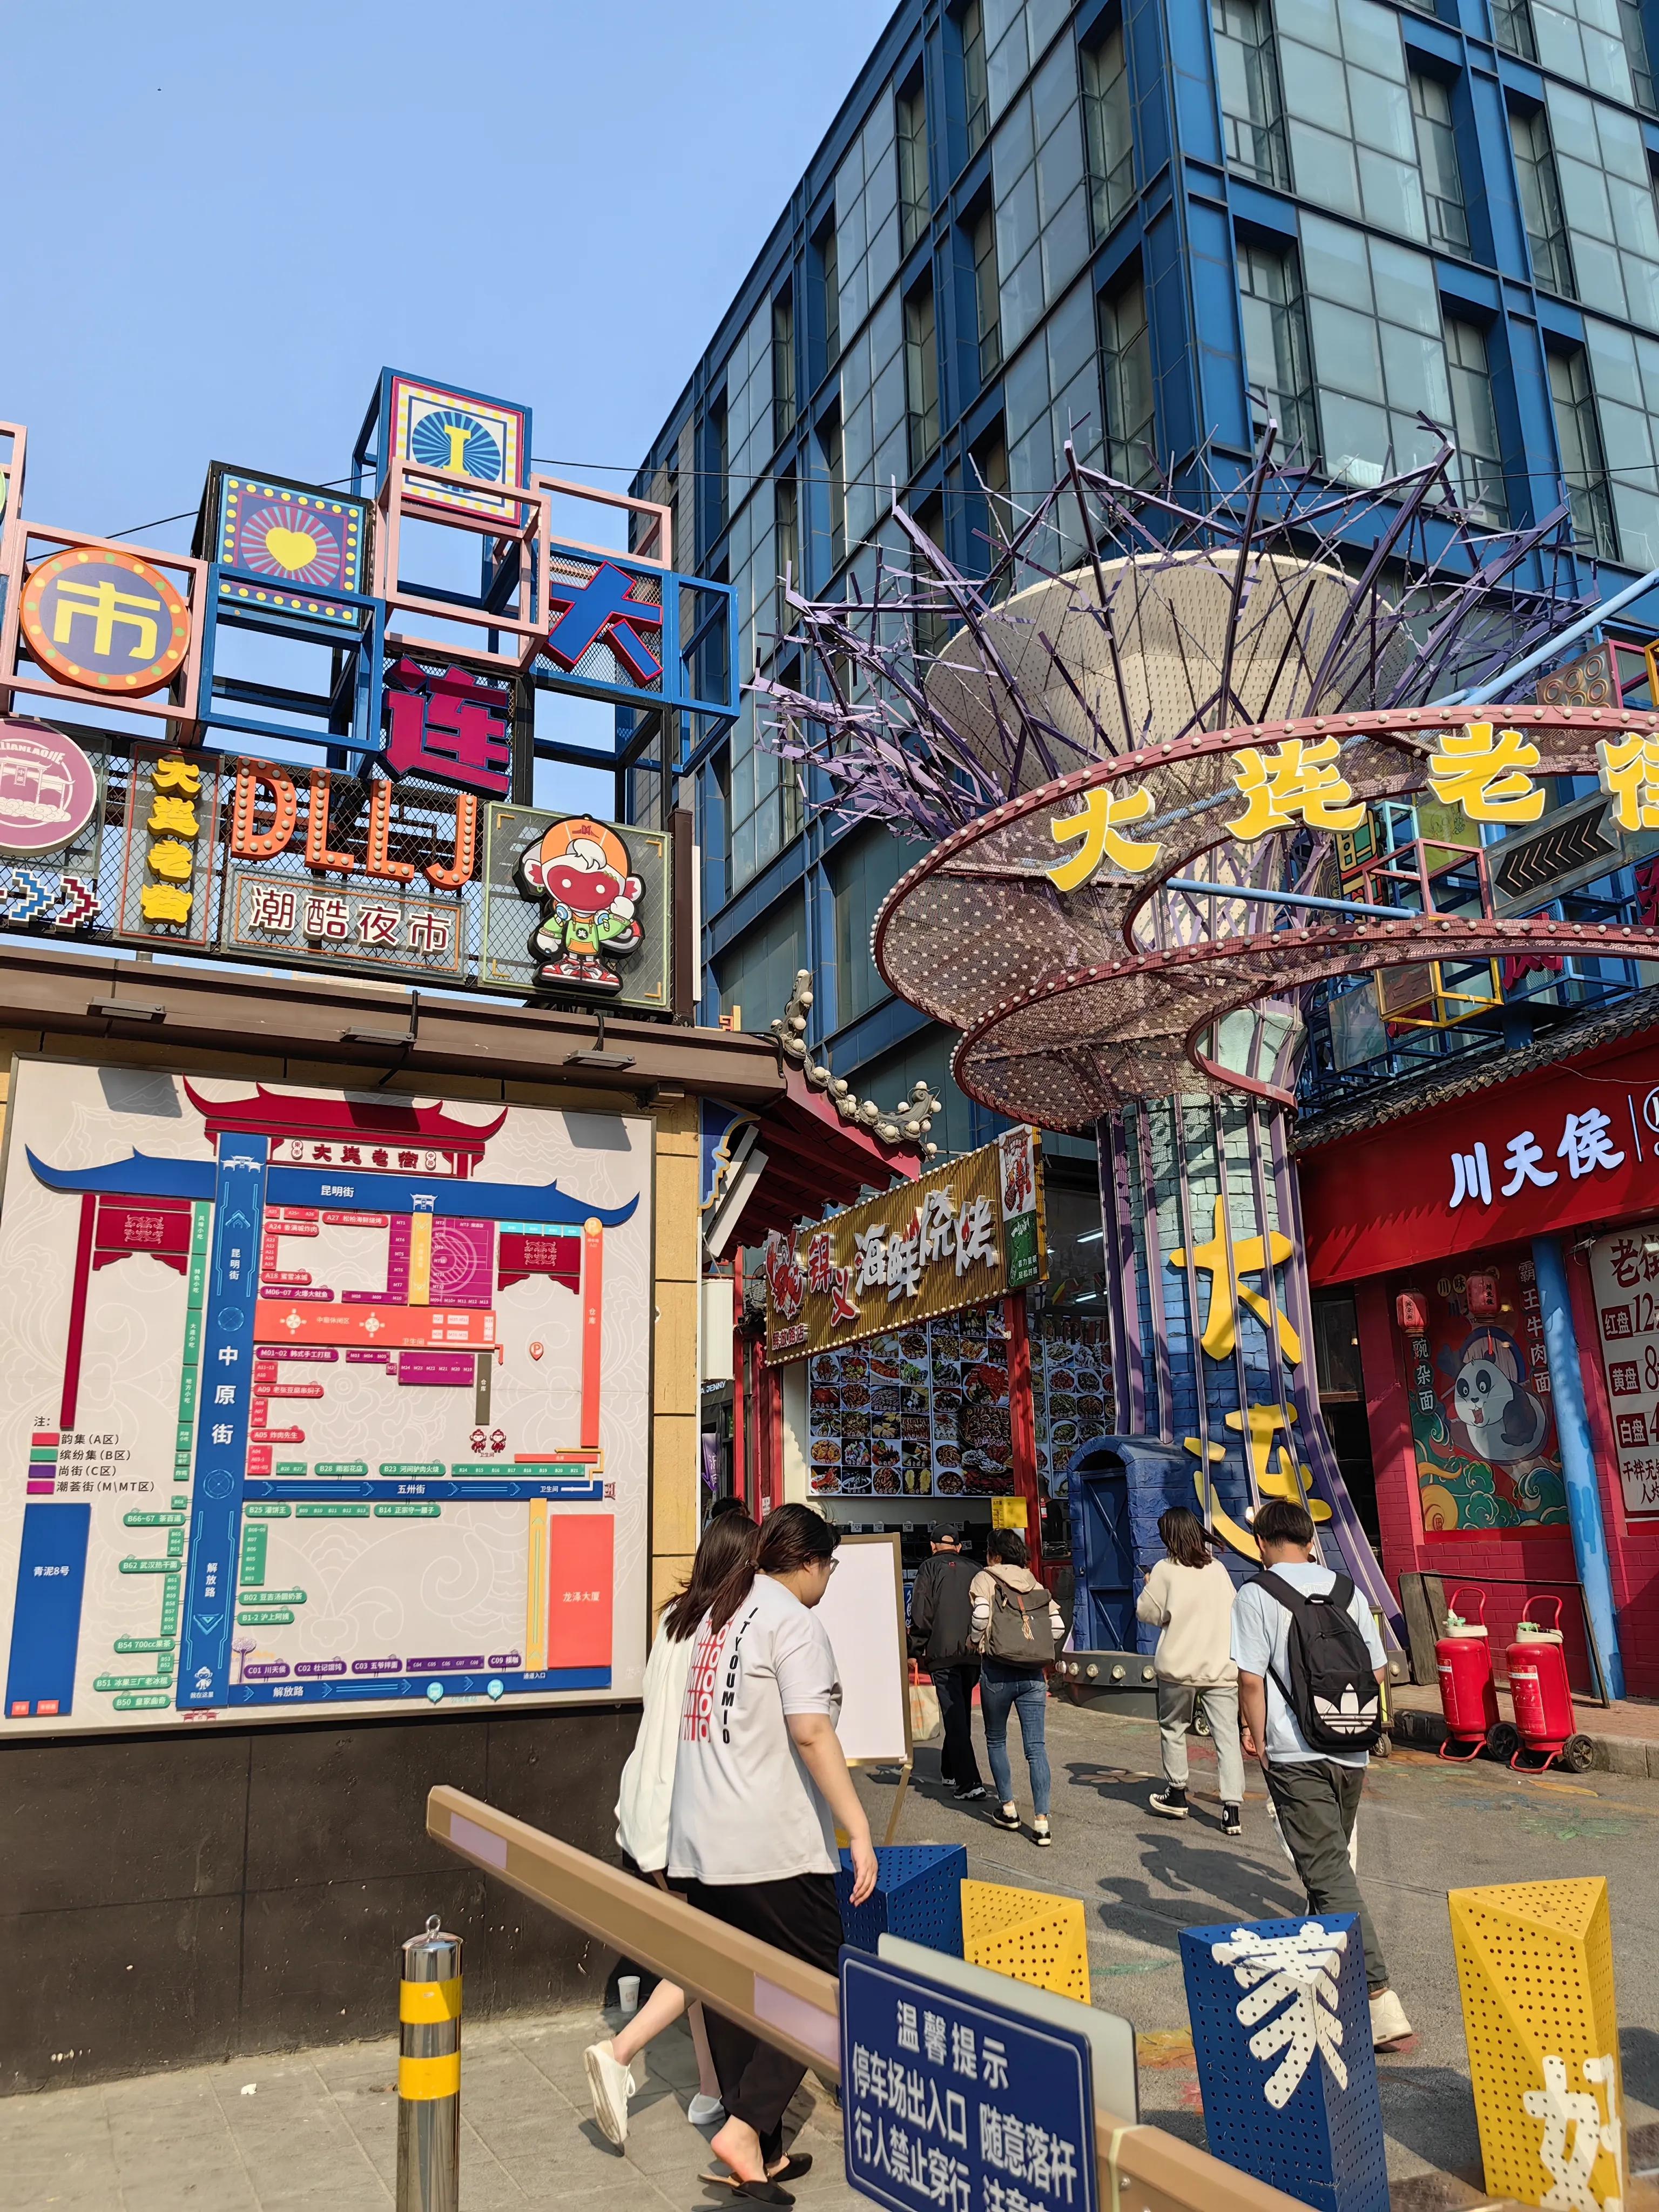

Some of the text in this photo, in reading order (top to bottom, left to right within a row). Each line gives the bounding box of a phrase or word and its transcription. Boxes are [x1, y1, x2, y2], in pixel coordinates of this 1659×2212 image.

[53, 579, 160, 659] 市
[0, 741, 65, 765] LIANLAOJIE
[231, 756, 477, 891] DLLJ
[250, 885, 451, 954] 潮酷夜市
[1449, 1108, 1624, 1208] 川天侯
[321, 1185, 354, 1197] 昆明街
[229, 1249, 241, 1280] 昆明街
[589, 1308, 596, 1324] 仓库
[1519, 1260, 1551, 1393] 霸王牛肉面
[1605, 1312, 1630, 1335] 红盘
[481, 1379, 487, 1392] 仓库
[706, 1381, 726, 1393] JENNY
[1613, 1367, 1638, 1391] 黄盘
[212, 1345, 238, 1445] 中原街
[1620, 1419, 1645, 1444] 白盘
[1623, 1459, 1659, 1482] 干拌无
[33, 1566, 70, 1576] 青泥8号
[205, 1563, 218, 1597] 解放路
[563, 1591, 599, 1603] 龙泽大厦
[264, 1665, 286, 1674] 川天侯
[136, 1697, 166, 1705] 皇家曲奇
[273, 1686, 304, 1697] 解放路
[895, 1999, 1009, 2090] 温馨提示
[852, 2042, 1077, 2204] 停车场出入口 随意落杆
[854, 2106, 971, 2212] 行人禁止穿行
